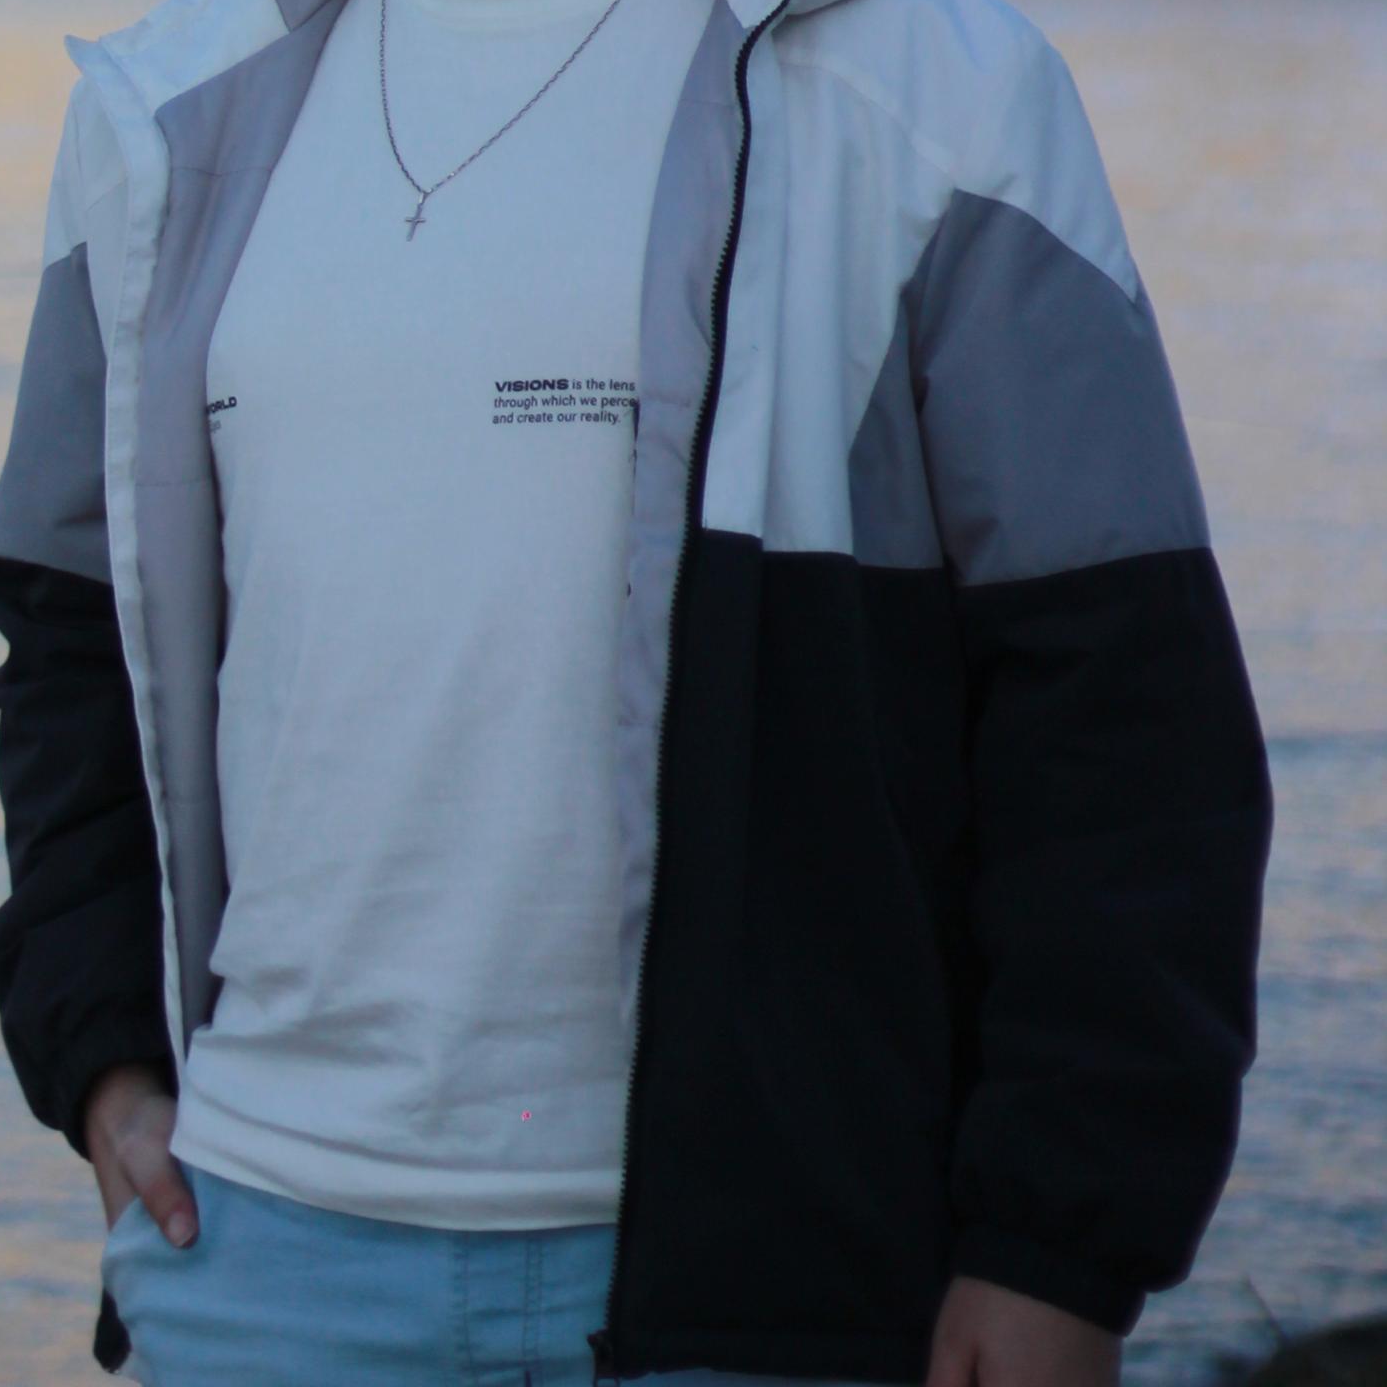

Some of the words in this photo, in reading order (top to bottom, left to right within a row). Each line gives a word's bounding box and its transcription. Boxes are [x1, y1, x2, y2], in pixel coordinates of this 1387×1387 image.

[495, 378, 569, 392] VISIONS
[572, 379, 582, 390] is
[586, 378, 606, 390] the
[609, 379, 635, 391] lens
[494, 395, 537, 410] through
[541, 395, 576, 407] which
[579, 397, 597, 406] we
[601, 396, 635, 409] perce
[492, 412, 514, 424] and
[516, 412, 553, 424] create
[557, 414, 576, 423] our
[580, 411, 621, 426] reality.
